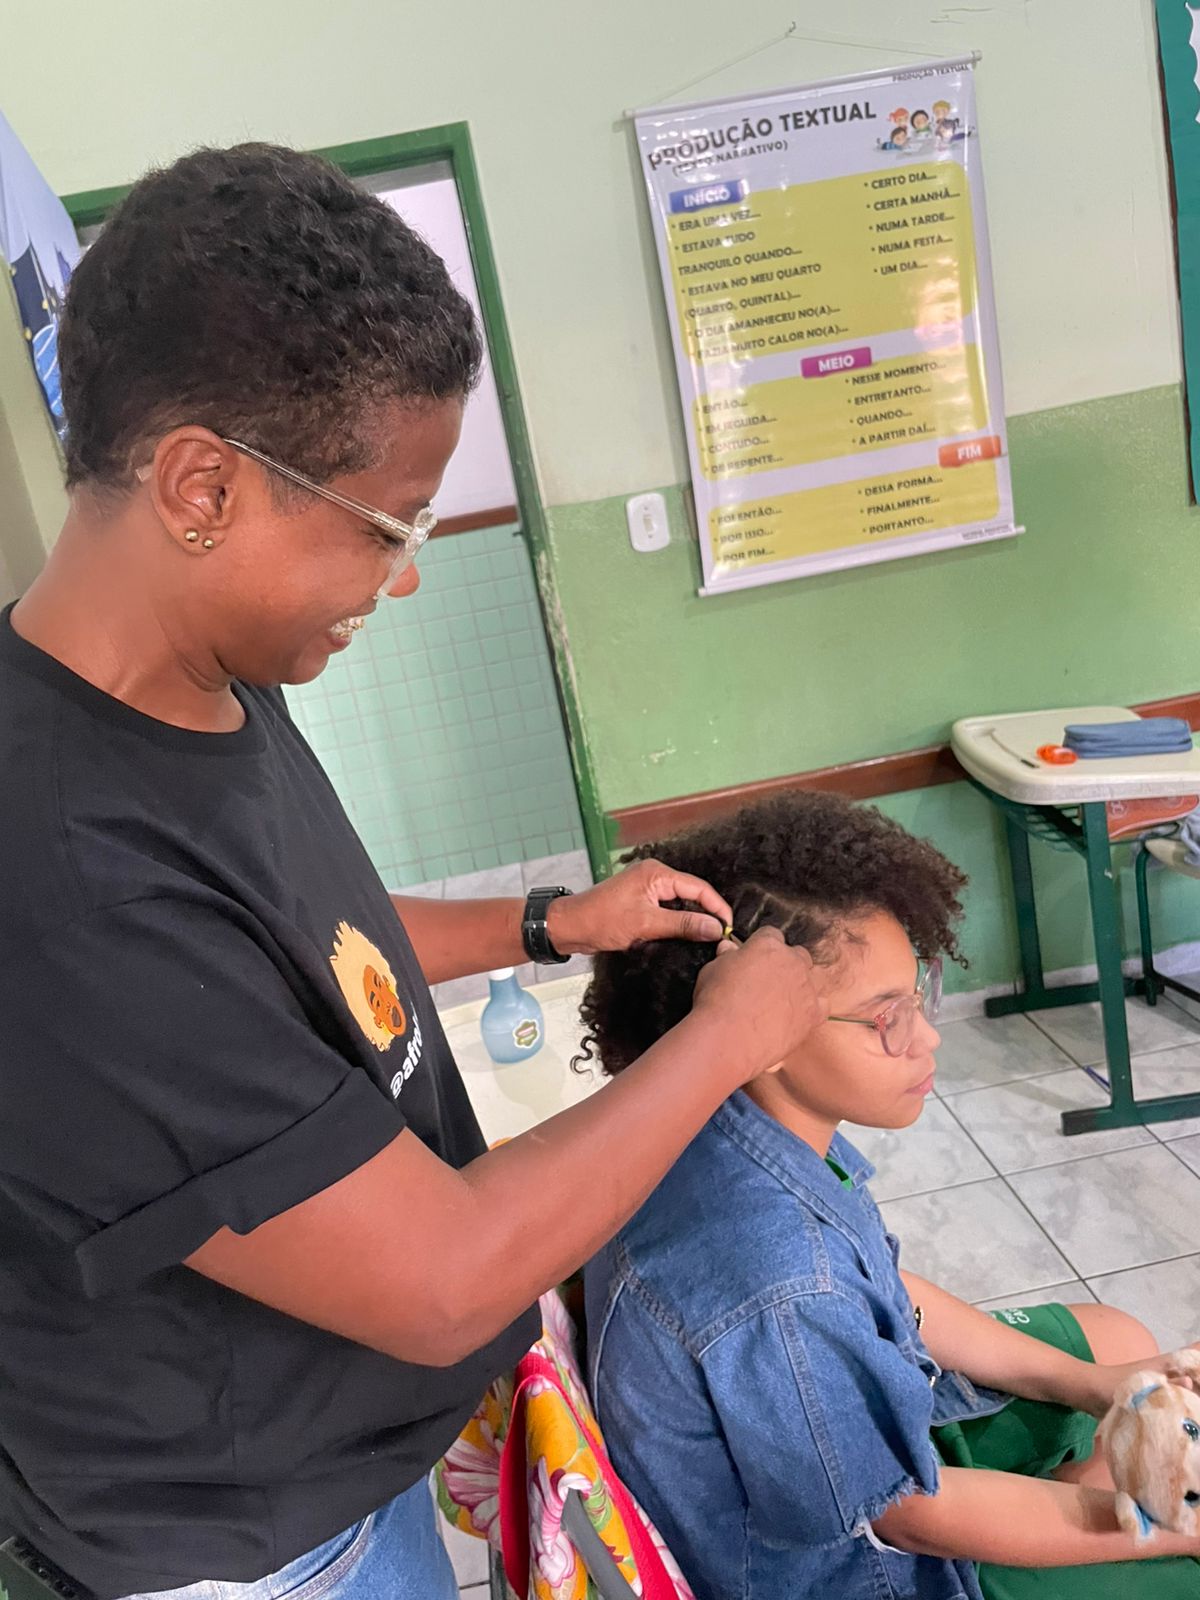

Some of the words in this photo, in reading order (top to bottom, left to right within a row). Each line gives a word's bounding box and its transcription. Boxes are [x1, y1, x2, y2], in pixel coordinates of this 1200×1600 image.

[648, 118, 773, 170] PRODUÇÃO
[779, 102, 877, 132] TEXTUAL
[716, 140, 788, 162] NARRATIVO)
[871, 175, 906, 189] CERTO
[909, 171, 937, 183] DIA...
[683, 183, 730, 208] INÍCIO
[874, 197, 908, 211] CERTA
[910, 187, 960, 204] MANHÃ...
[679, 219, 701, 231] ERA
[876, 219, 908, 232] NUMA
[912, 212, 954, 226] TARDE...
[682, 238, 722, 253] ESTAVA
[878, 240, 911, 254] NUMA
[914, 235, 953, 248] FESTA...
[679, 256, 741, 276] TRANQUILO
[744, 246, 802, 264] QUANDO...
[880, 265, 897, 276] UM
[900, 260, 928, 272] DIA...
[688, 282, 729, 296] ESTAVA
[731, 277, 748, 288] NO
[751, 273, 774, 285] MEU
[776, 263, 821, 280] QUARTO
[695, 329, 702, 338] O
[707, 324, 728, 336] DIA
[728, 311, 796, 331] AMANHECEU
[768, 330, 804, 346] CALOR
[817, 354, 855, 373] MEIO
[852, 372, 881, 386] NESSE
[854, 384, 932, 406] ENTRETANTO...
[857, 408, 912, 426] QUANDO...
[859, 436, 867, 446] A
[869, 428, 906, 444] PARTIR
[957, 445, 983, 460] FIM
[864, 483, 894, 497] DESSA
[897, 475, 943, 489] FORMA...
[867, 496, 940, 515] FINALMENTE...
[869, 516, 934, 534] PORTANTO...
[720, 533, 742, 544] POR
[723, 552, 745, 563] POR
